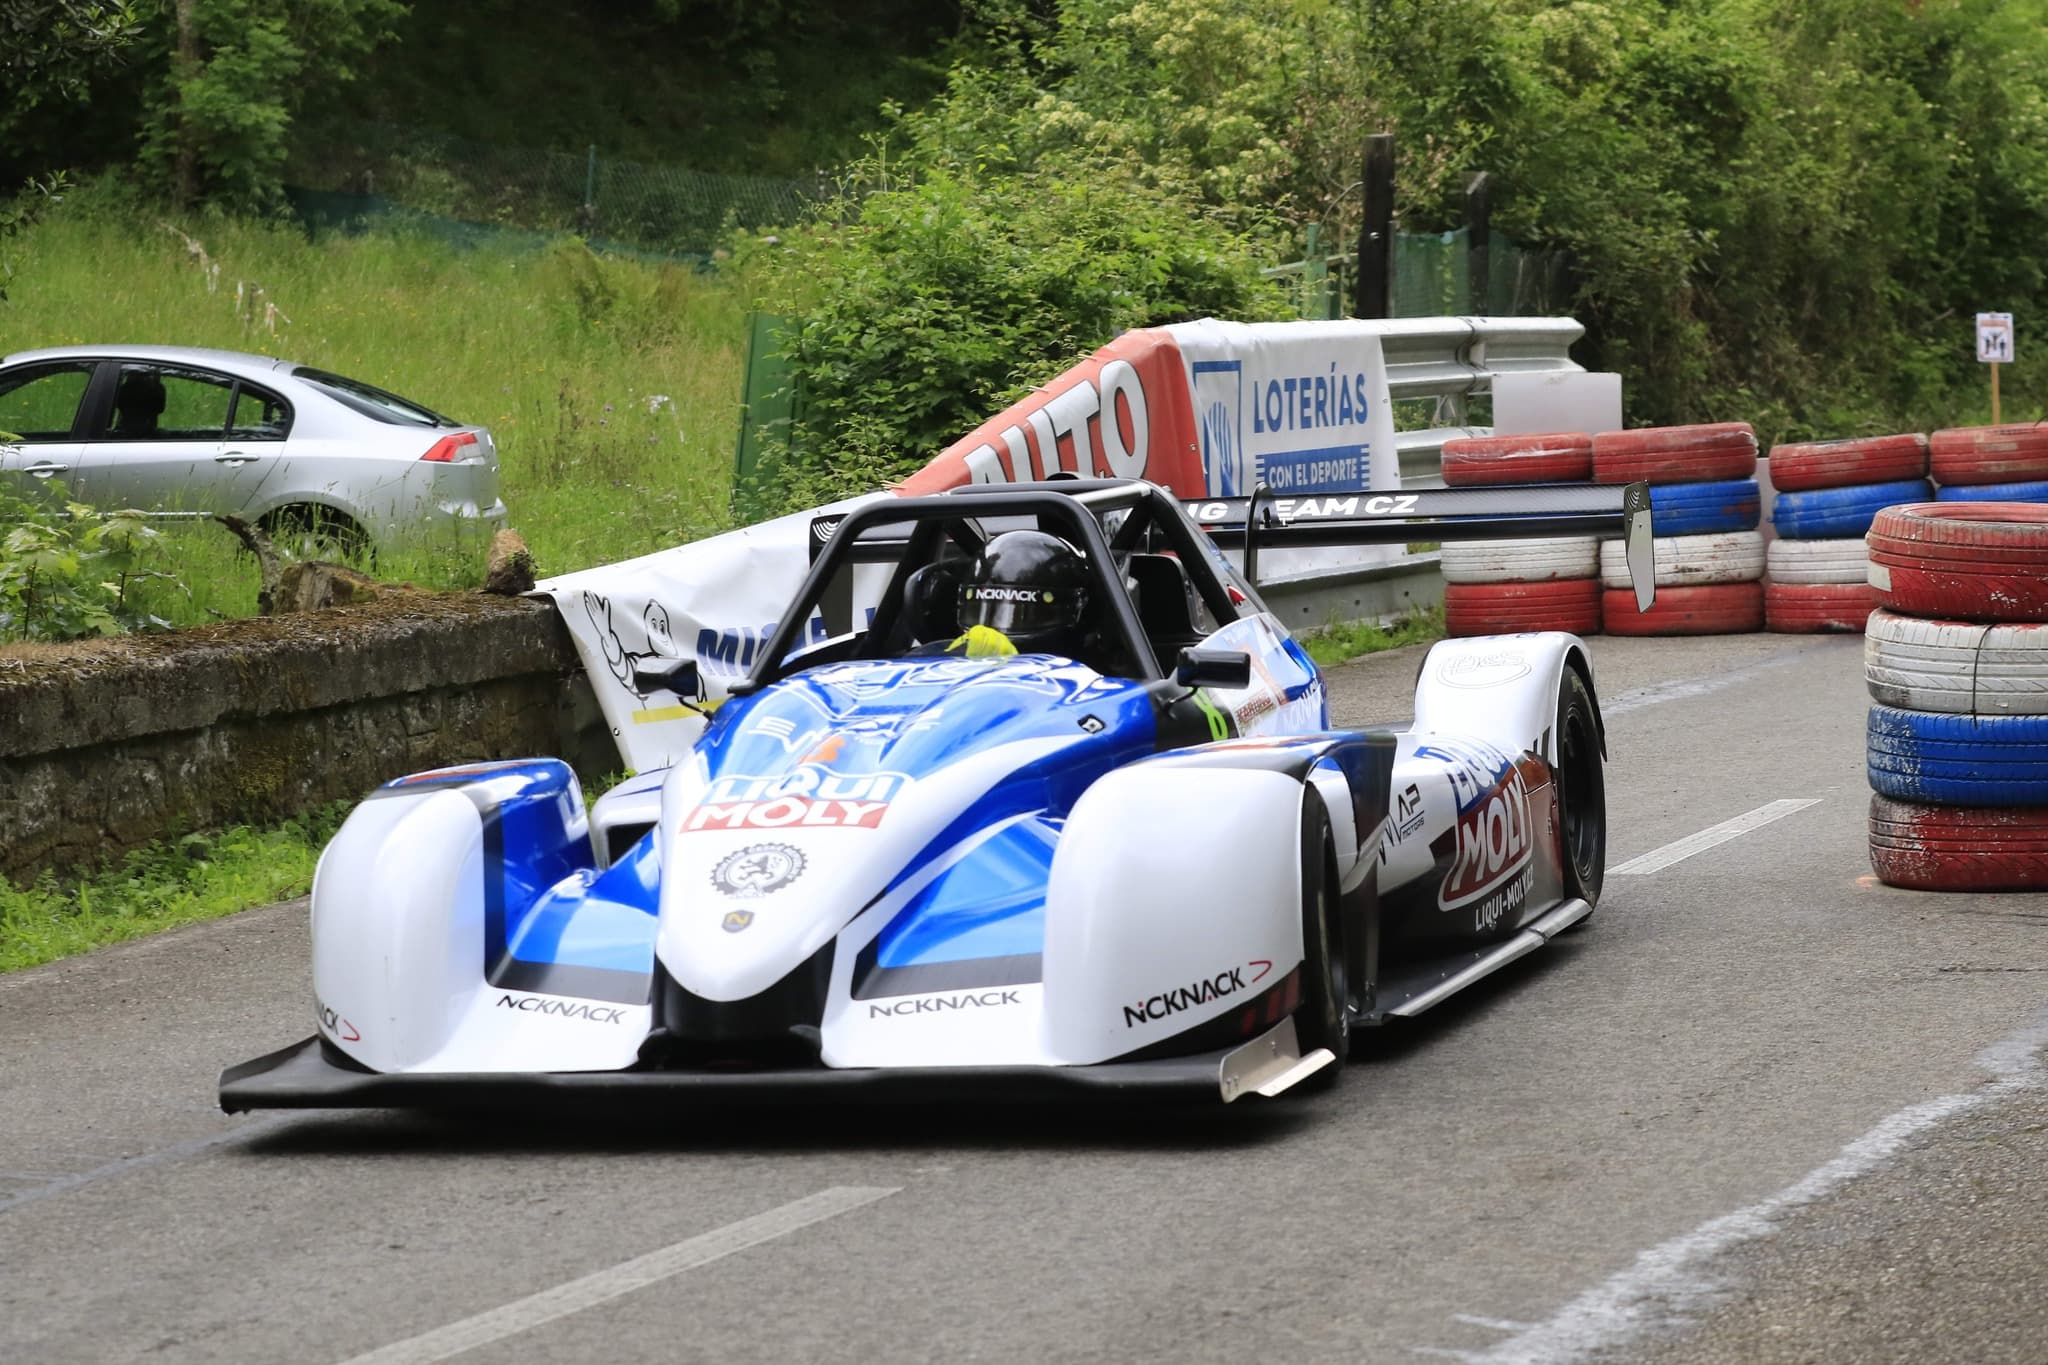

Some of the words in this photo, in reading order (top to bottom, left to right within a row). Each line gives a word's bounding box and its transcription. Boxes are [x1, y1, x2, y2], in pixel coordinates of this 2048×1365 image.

[1254, 361, 1368, 433] LOTERÍAS
[1269, 466, 1293, 488] CON
[1296, 463, 1308, 485] EL
[1311, 458, 1358, 484] DEPORTE
[1246, 498, 1359, 521] EAM
[1365, 495, 1419, 514] CZ
[713, 767, 891, 800] LIQUI
[689, 797, 877, 828] MOLY
[1451, 773, 1528, 893] MOLY
